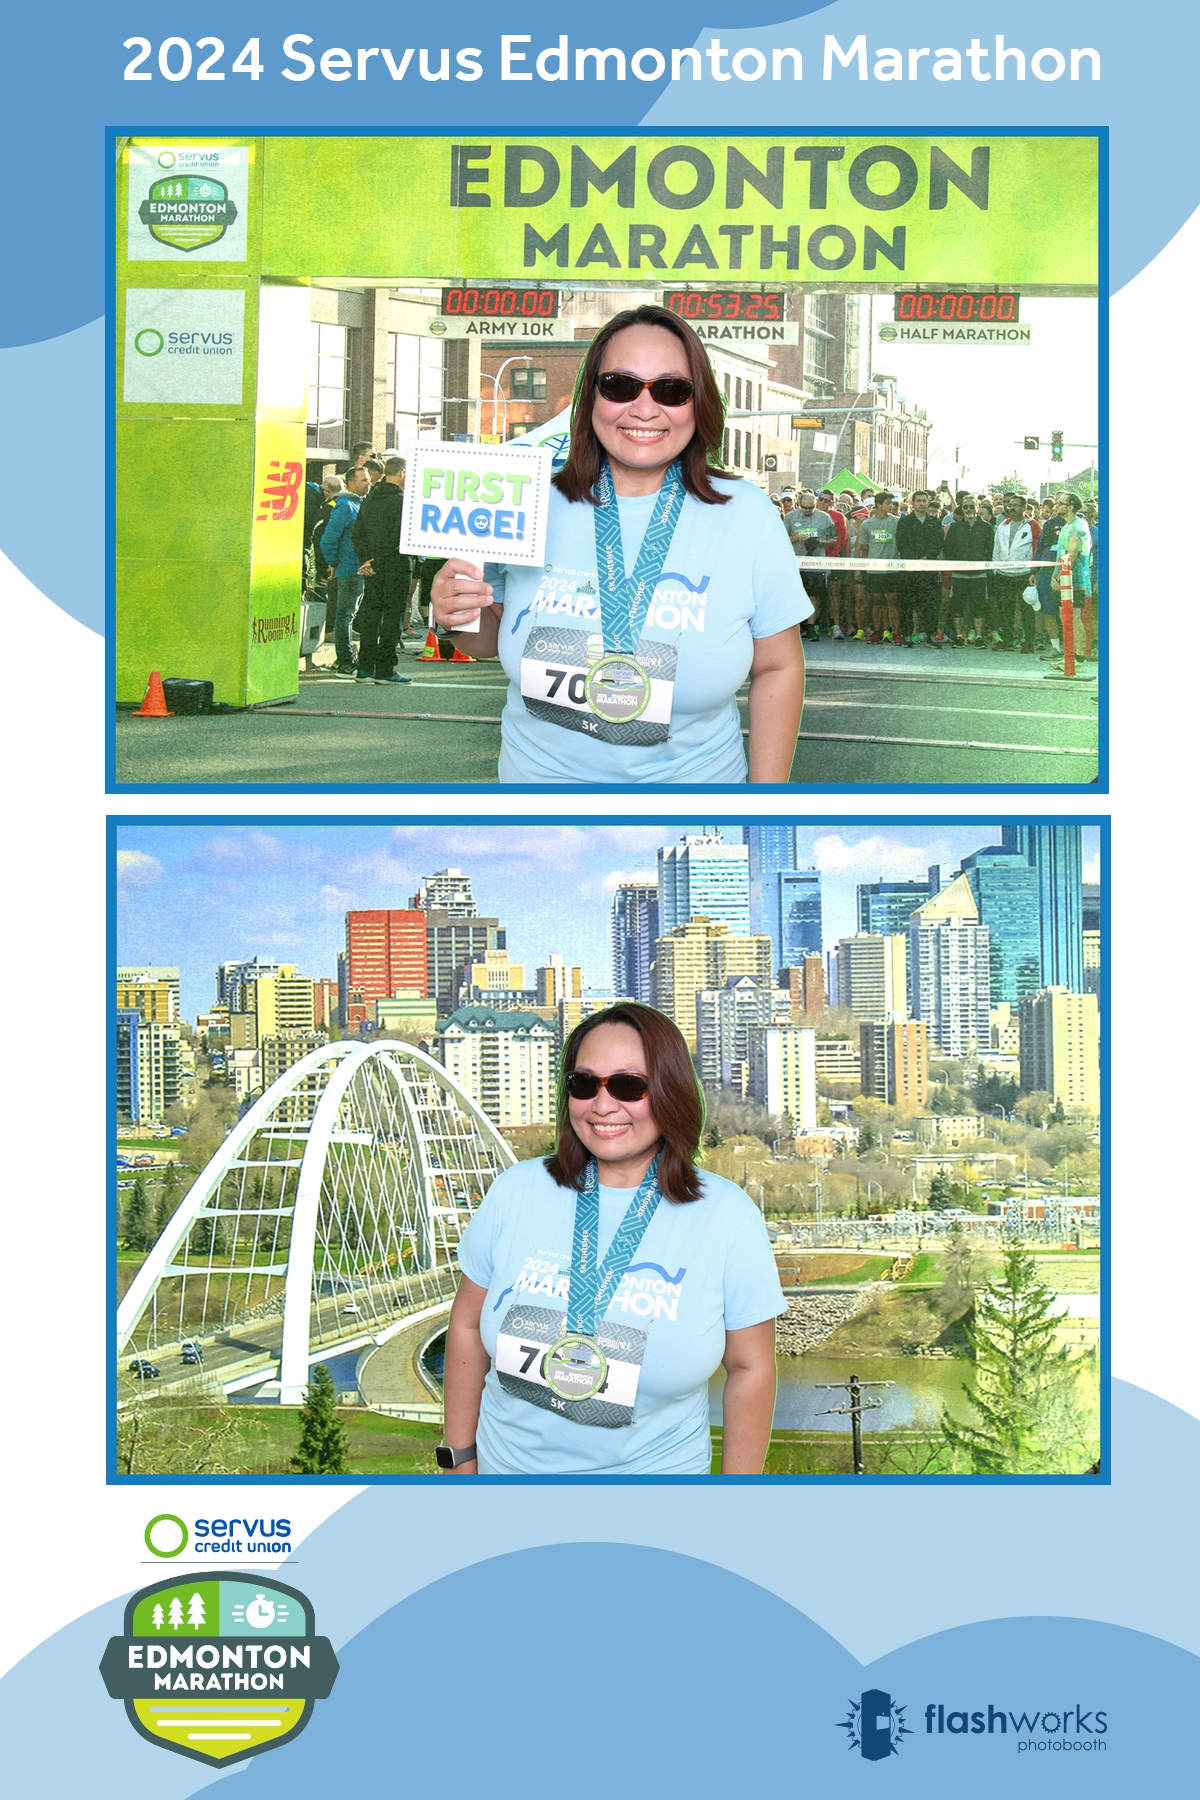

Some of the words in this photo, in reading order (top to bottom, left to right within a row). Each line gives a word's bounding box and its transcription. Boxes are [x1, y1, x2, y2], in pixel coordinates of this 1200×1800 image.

[178, 152, 220, 161] servus
[450, 144, 991, 211] EDMONTON
[149, 202, 227, 214] EDMONTON
[160, 214, 215, 222] MARATHON
[522, 222, 907, 272] MARATHON
[466, 321, 518, 336] ARMY
[521, 322, 555, 337] 10K
[694, 325, 785, 340] ARATHON
[900, 328, 939, 340] HALF
[942, 328, 1031, 341] MARATHON
[168, 332, 233, 345] servus
[168, 345, 200, 355] credit
[202, 347, 233, 355] union
[422, 468, 531, 506] FIRST
[661, 491, 677, 523] FINISHER
[420, 503, 526, 541] RACE!
[605, 545, 615, 580] FINISHER
[538, 575, 577, 593] 2024
[628, 581, 646, 618] FINISHER
[257, 613, 291, 643] Running
[596, 697, 638, 707] MARATHON
[582, 720, 599, 733] 5K
[636, 1186, 655, 1217] FINISHER
[580, 1229, 589, 1262] FINISHER
[522, 1257, 559, 1275] 2024
[594, 1270, 615, 1305] FINISHER
[550, 1398, 566, 1411] 5K
